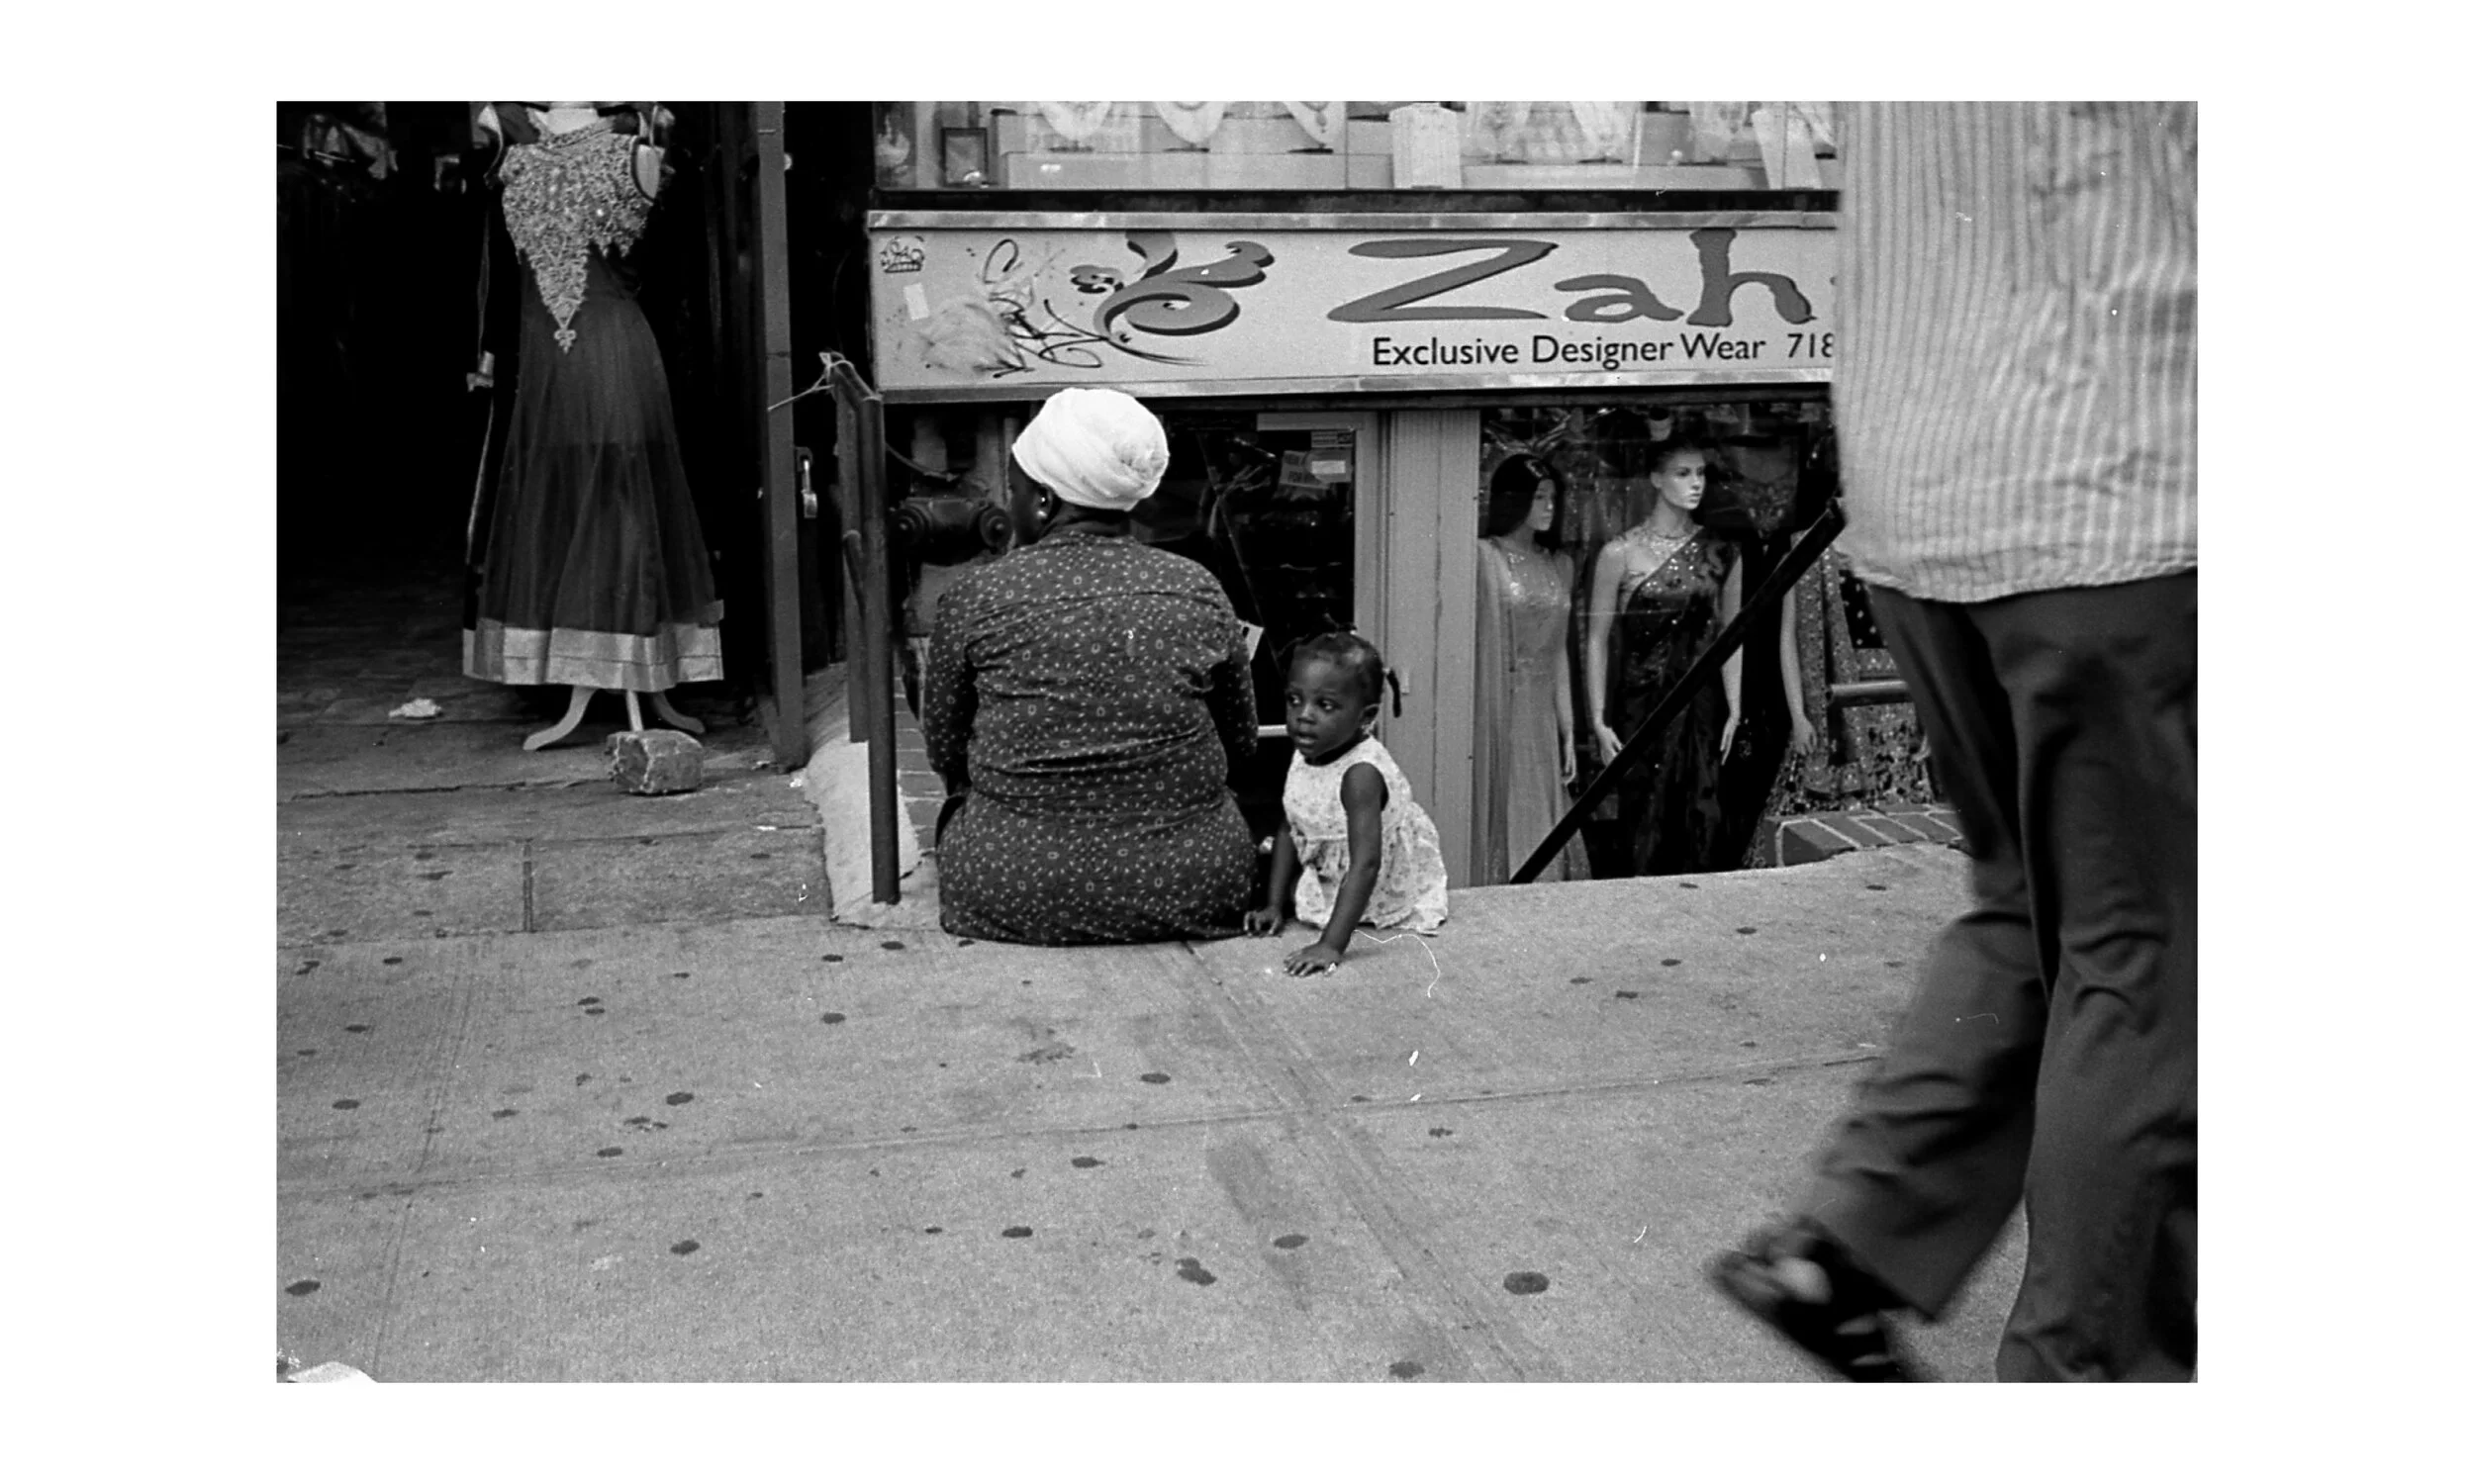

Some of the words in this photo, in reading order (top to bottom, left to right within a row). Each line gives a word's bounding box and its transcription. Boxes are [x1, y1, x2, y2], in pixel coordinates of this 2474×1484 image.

[1327, 229, 1835, 326] Zah
[1373, 336, 1519, 365] Exclusive
[1532, 334, 1674, 372] Designer
[1679, 332, 1766, 360] Wear
